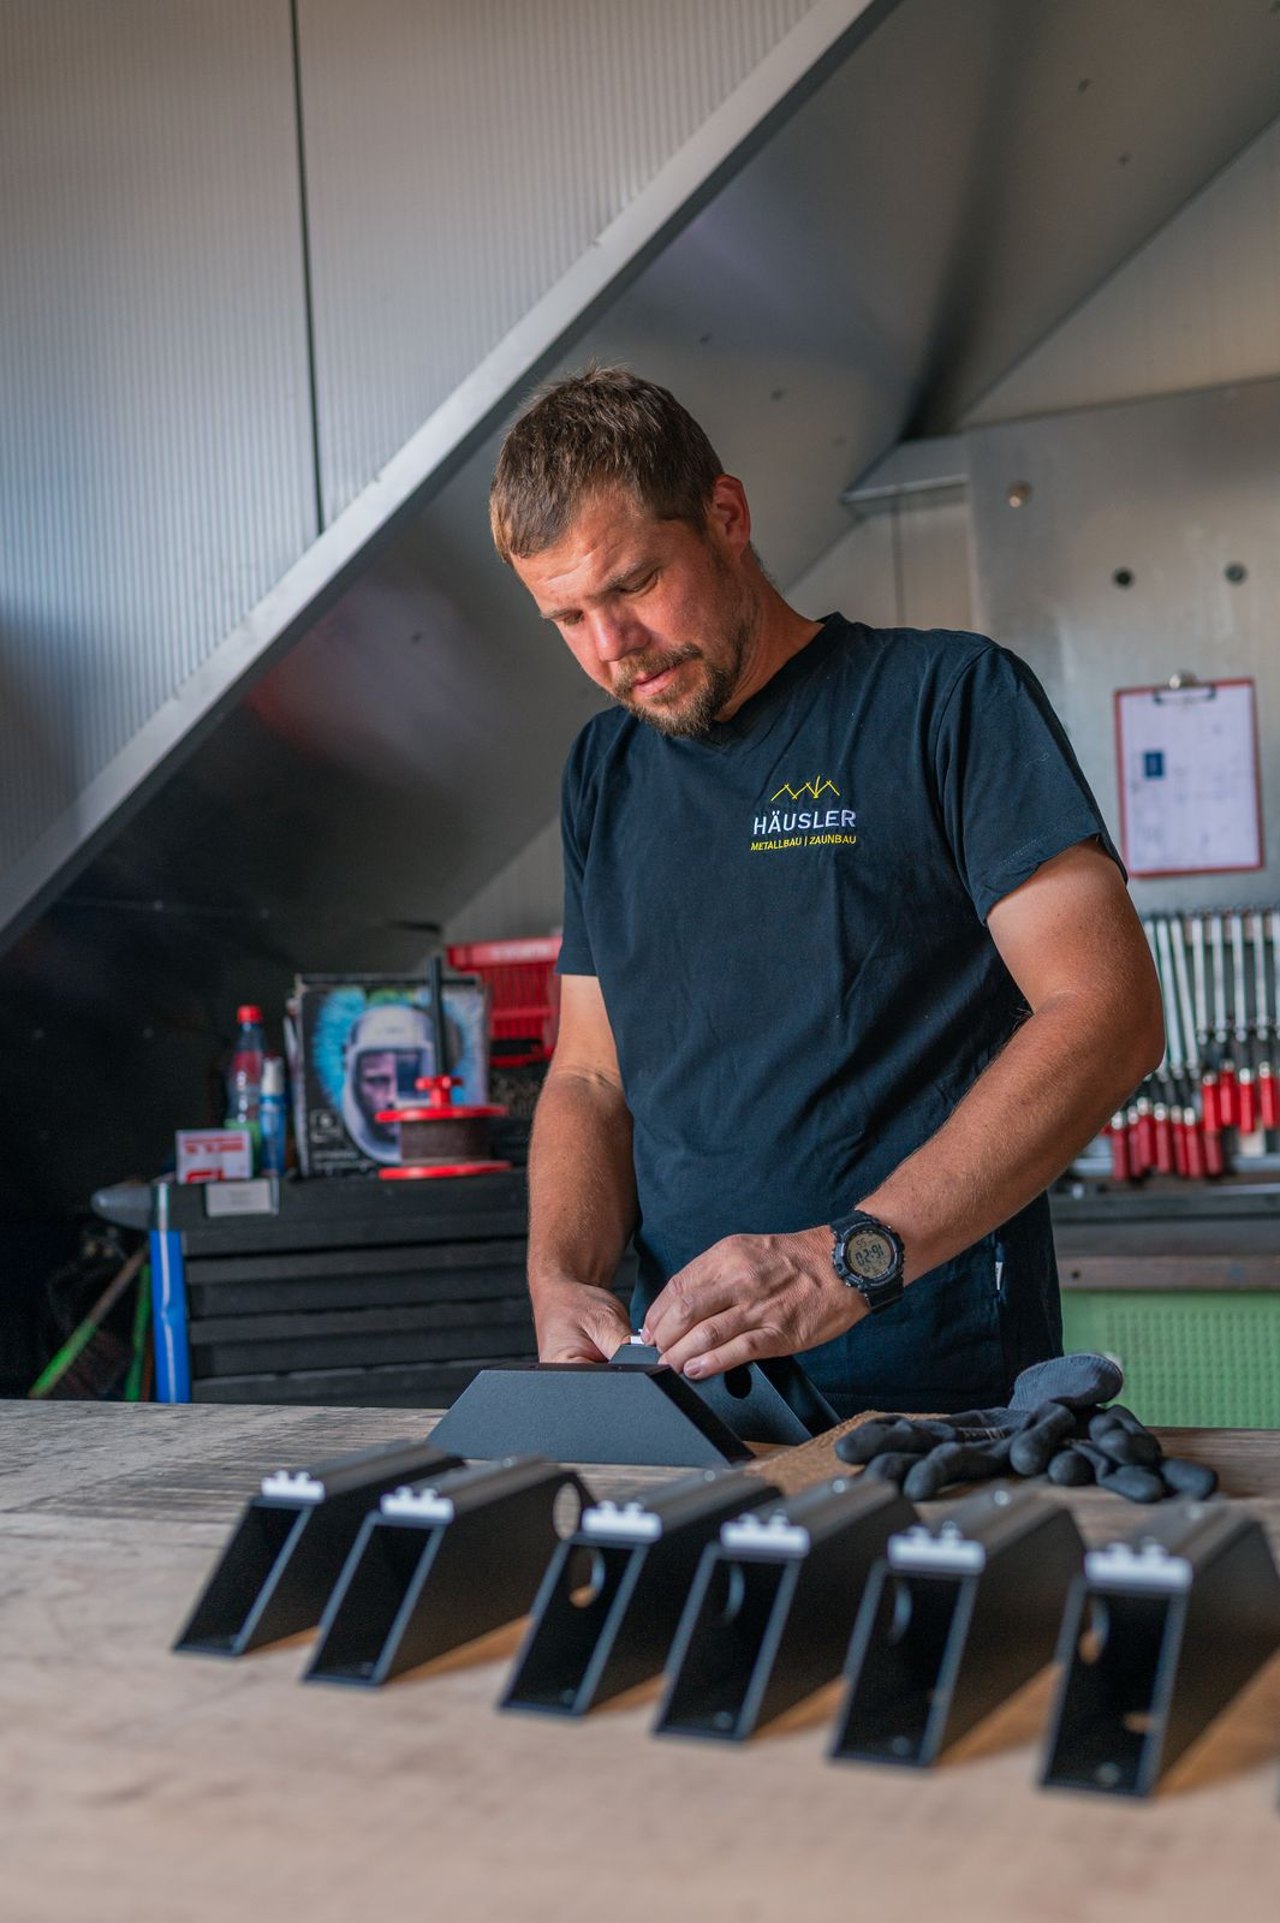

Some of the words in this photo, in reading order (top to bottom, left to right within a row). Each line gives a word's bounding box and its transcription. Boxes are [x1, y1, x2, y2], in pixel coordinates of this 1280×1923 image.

[753, 809, 857, 835] HÄUSLER
[750, 837, 802, 851] METALLBAU
[809, 834, 857, 846] ZAUNBAU
